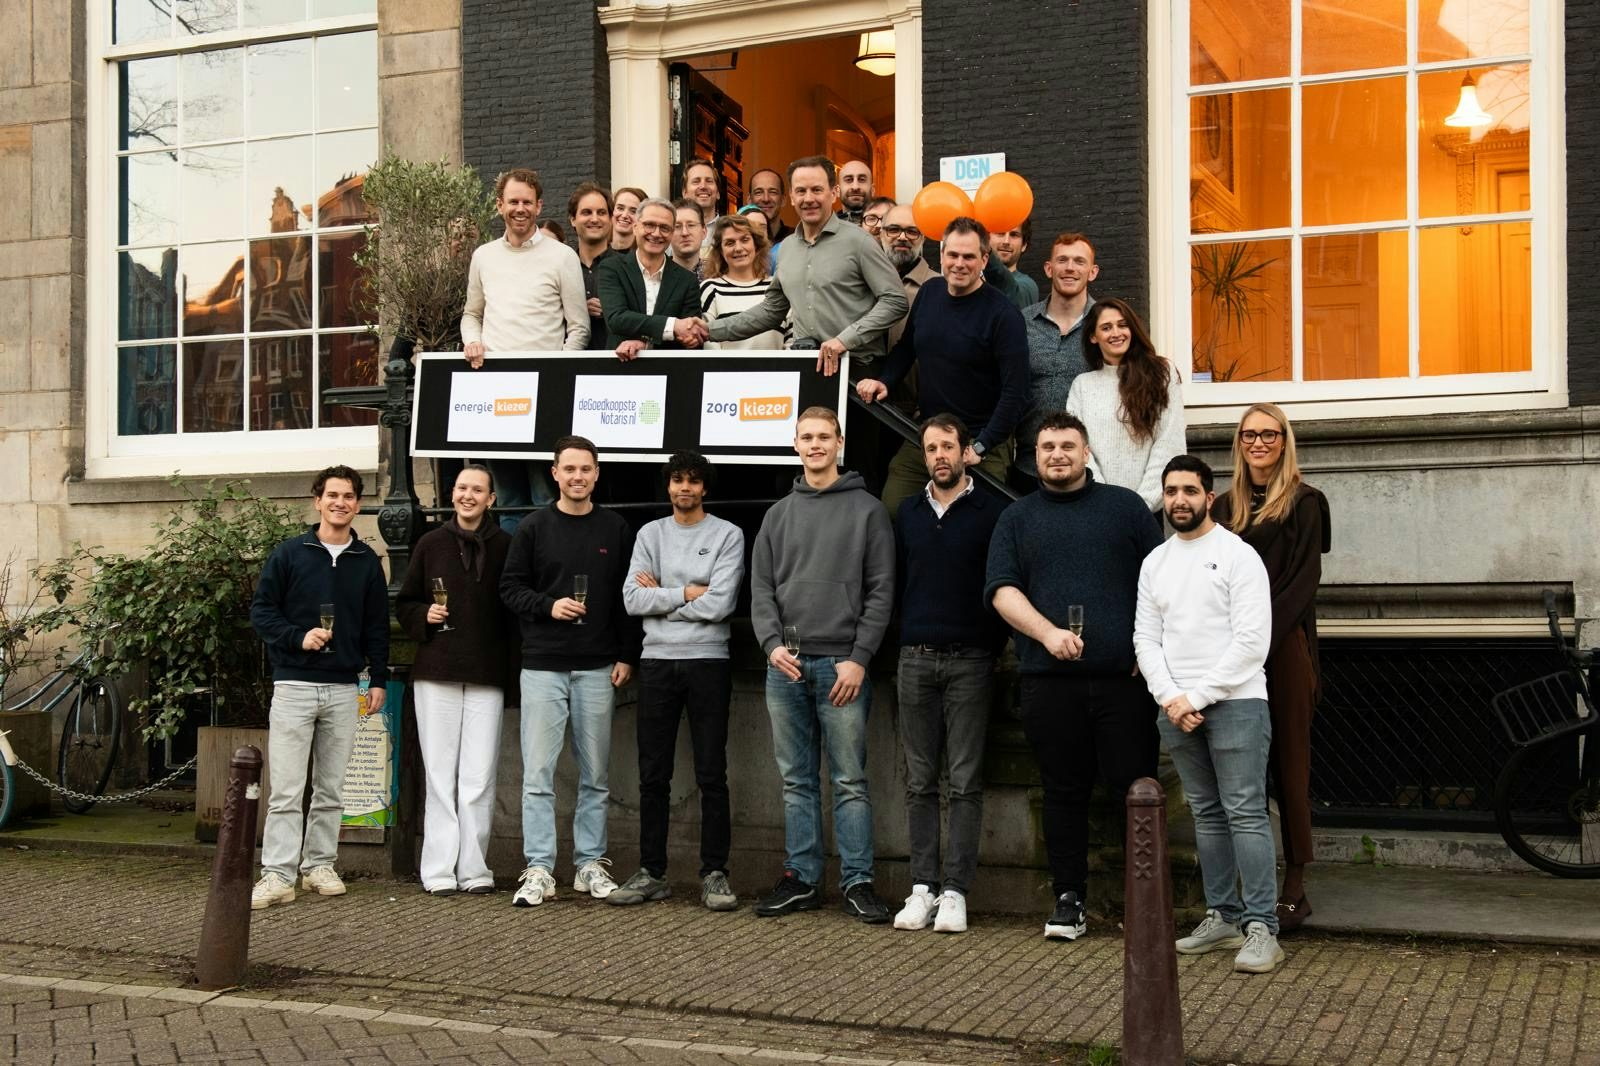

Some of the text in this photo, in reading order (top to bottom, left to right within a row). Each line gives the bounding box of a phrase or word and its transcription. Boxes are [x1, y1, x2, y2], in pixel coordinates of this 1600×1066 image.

[955, 157, 990, 180] DGN
[454, 402, 529, 414] energie kiezer
[578, 398, 637, 413] deGoedkoopste
[706, 401, 789, 417] zorg kiezer
[600, 411, 637, 425] Notaris.nl
